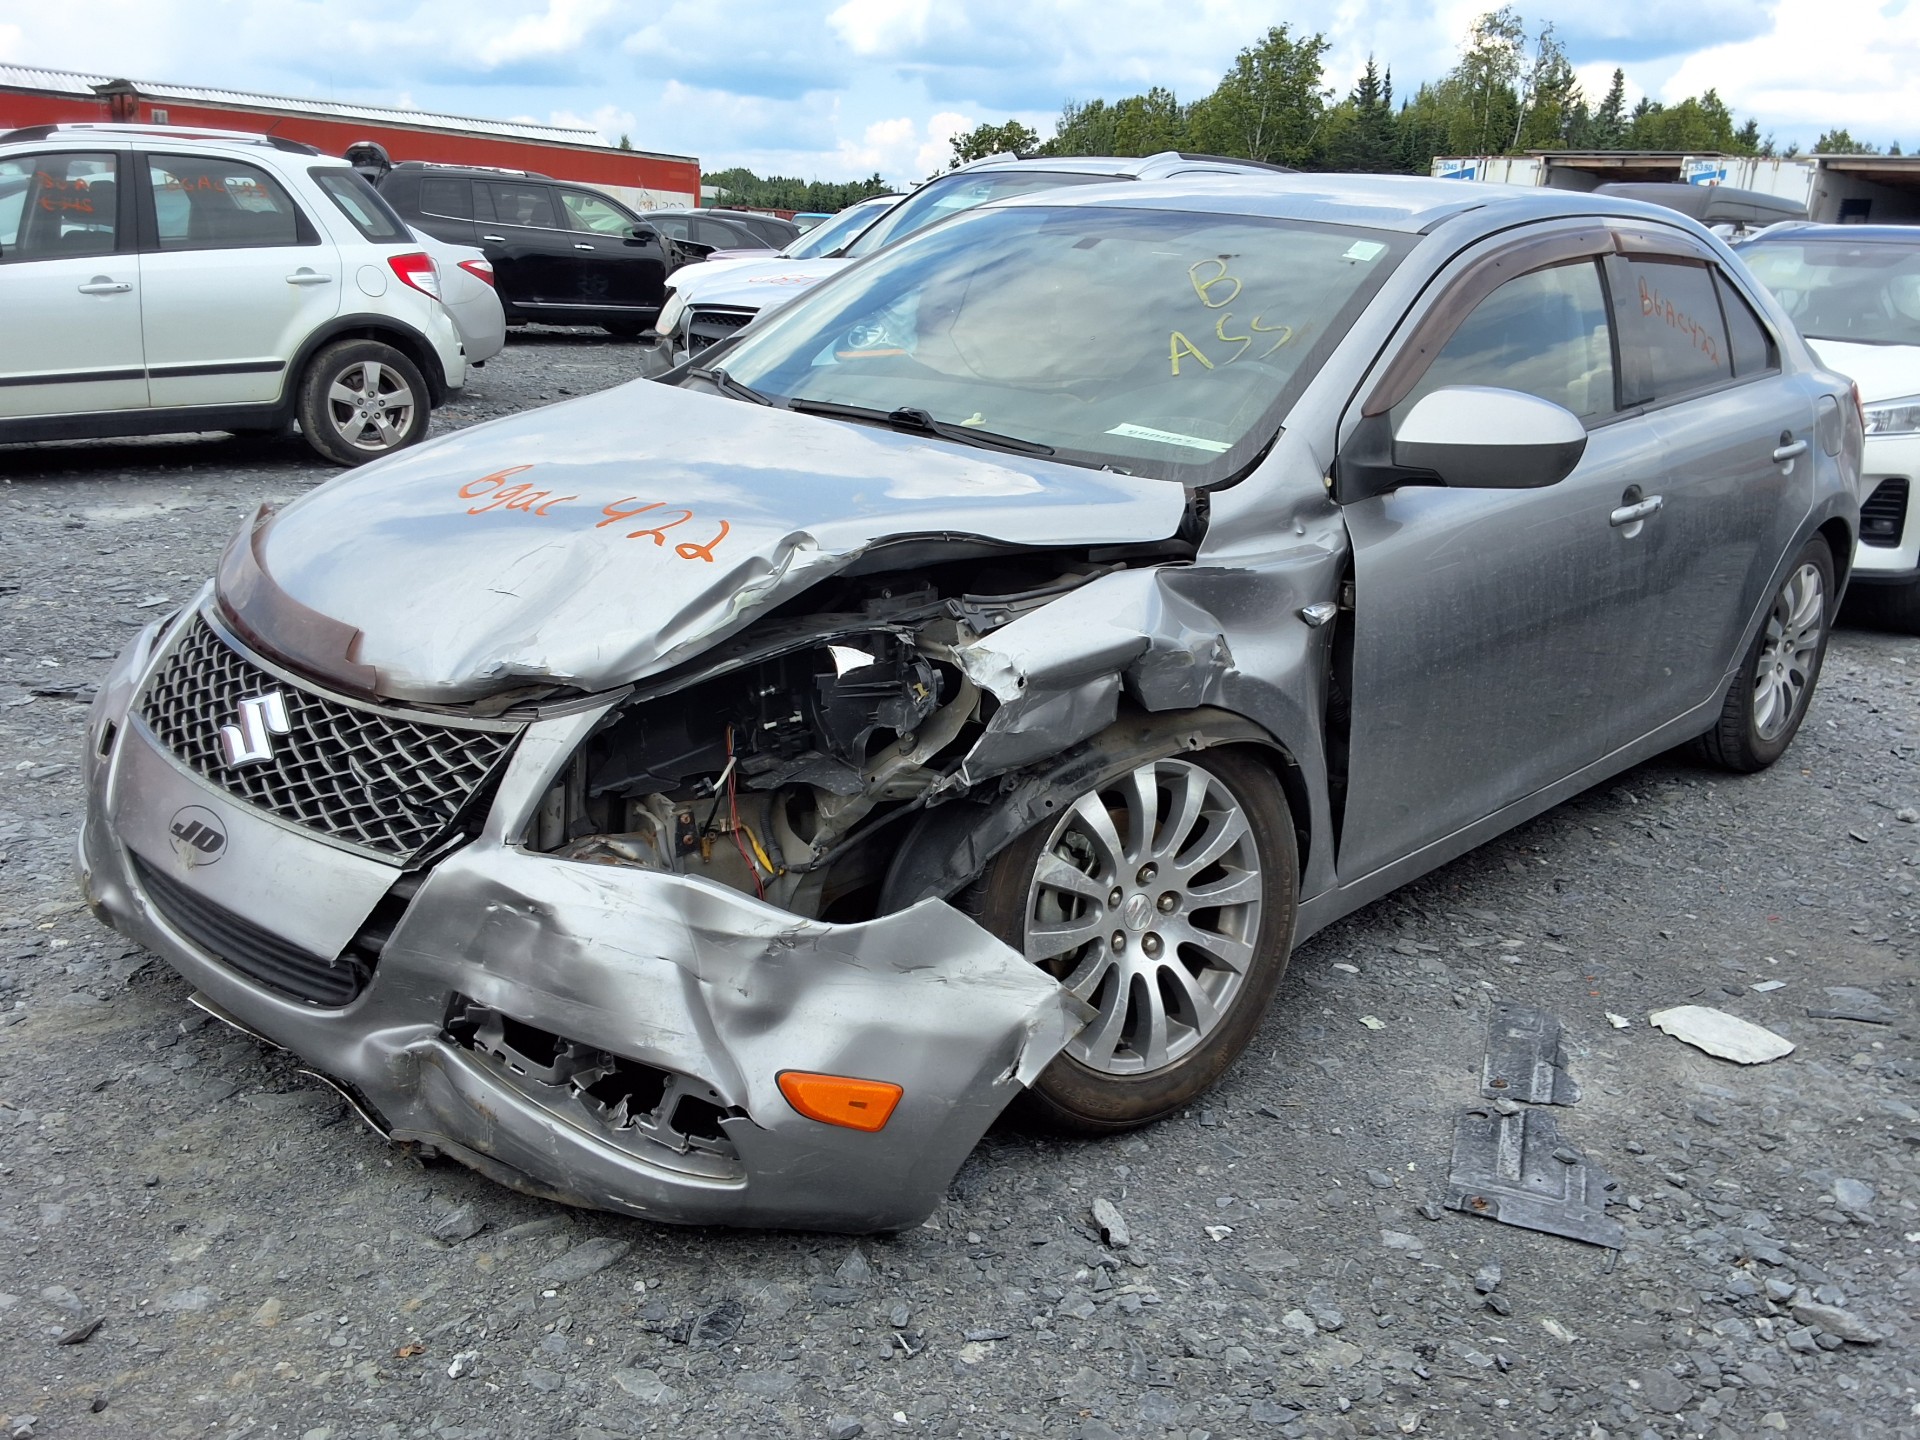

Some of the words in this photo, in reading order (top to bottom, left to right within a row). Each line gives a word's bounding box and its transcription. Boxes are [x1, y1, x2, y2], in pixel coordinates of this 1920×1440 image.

[1188, 258, 1242, 309] B
[1168, 311, 1293, 376] ASS
[595, 496, 731, 563] 422
